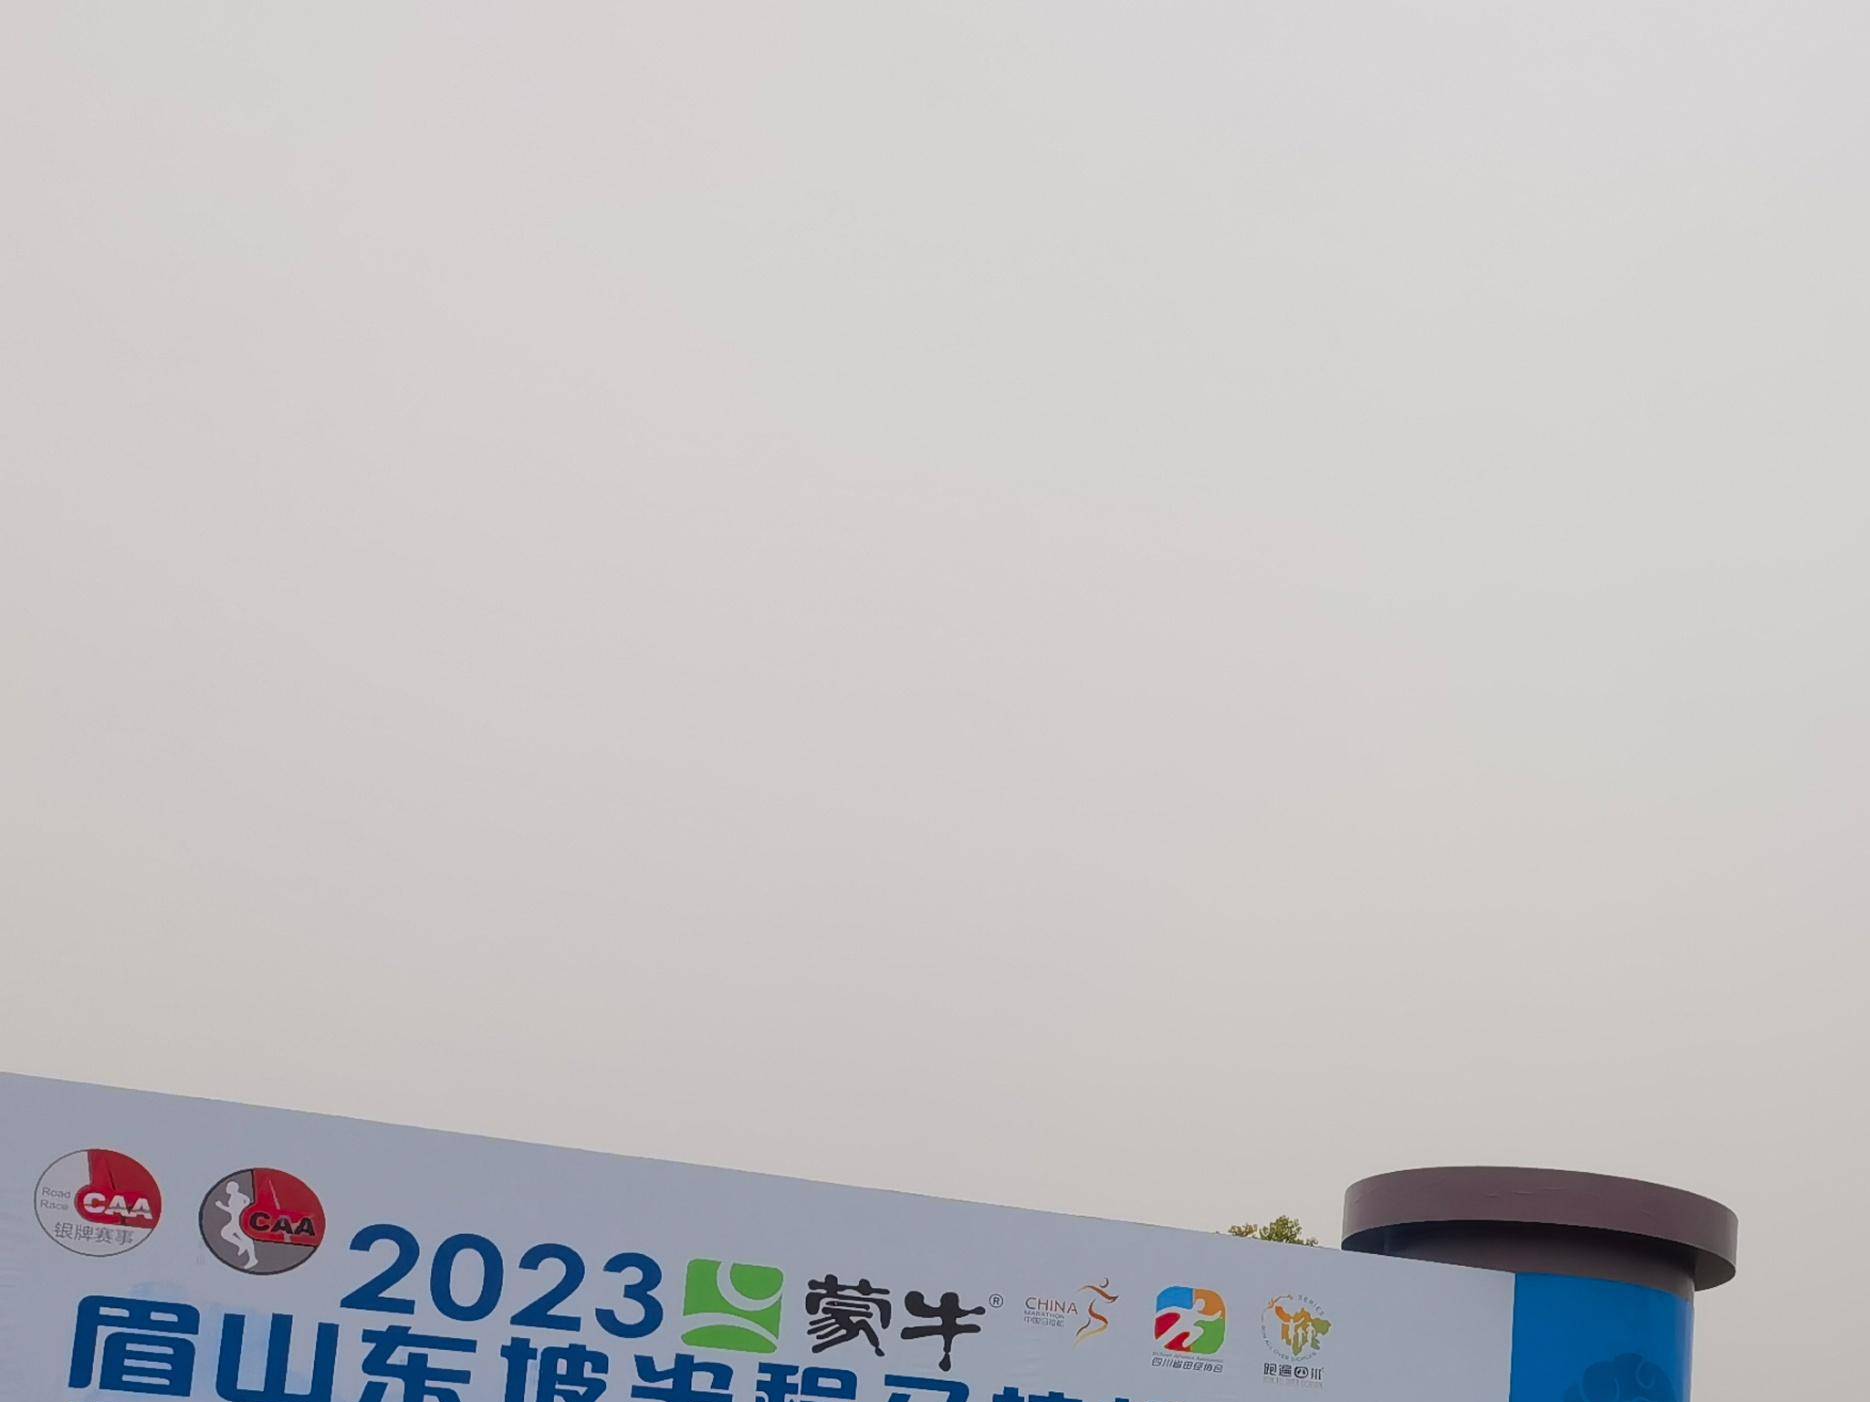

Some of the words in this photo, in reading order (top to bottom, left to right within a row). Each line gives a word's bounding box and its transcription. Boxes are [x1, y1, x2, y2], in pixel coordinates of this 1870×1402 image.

[42, 1187, 71, 1199] Road
[40, 1199, 69, 1211] Race
[83, 1192, 153, 1220] CAA
[54, 1222, 135, 1246] 银牌赛事
[250, 1212, 316, 1237] CAA
[340, 1224, 664, 1338] 2023
[805, 1273, 985, 1371] 蒙牛
[1025, 1296, 1078, 1316] CHINA
[1264, 1362, 1325, 1381] 跑遍四川
